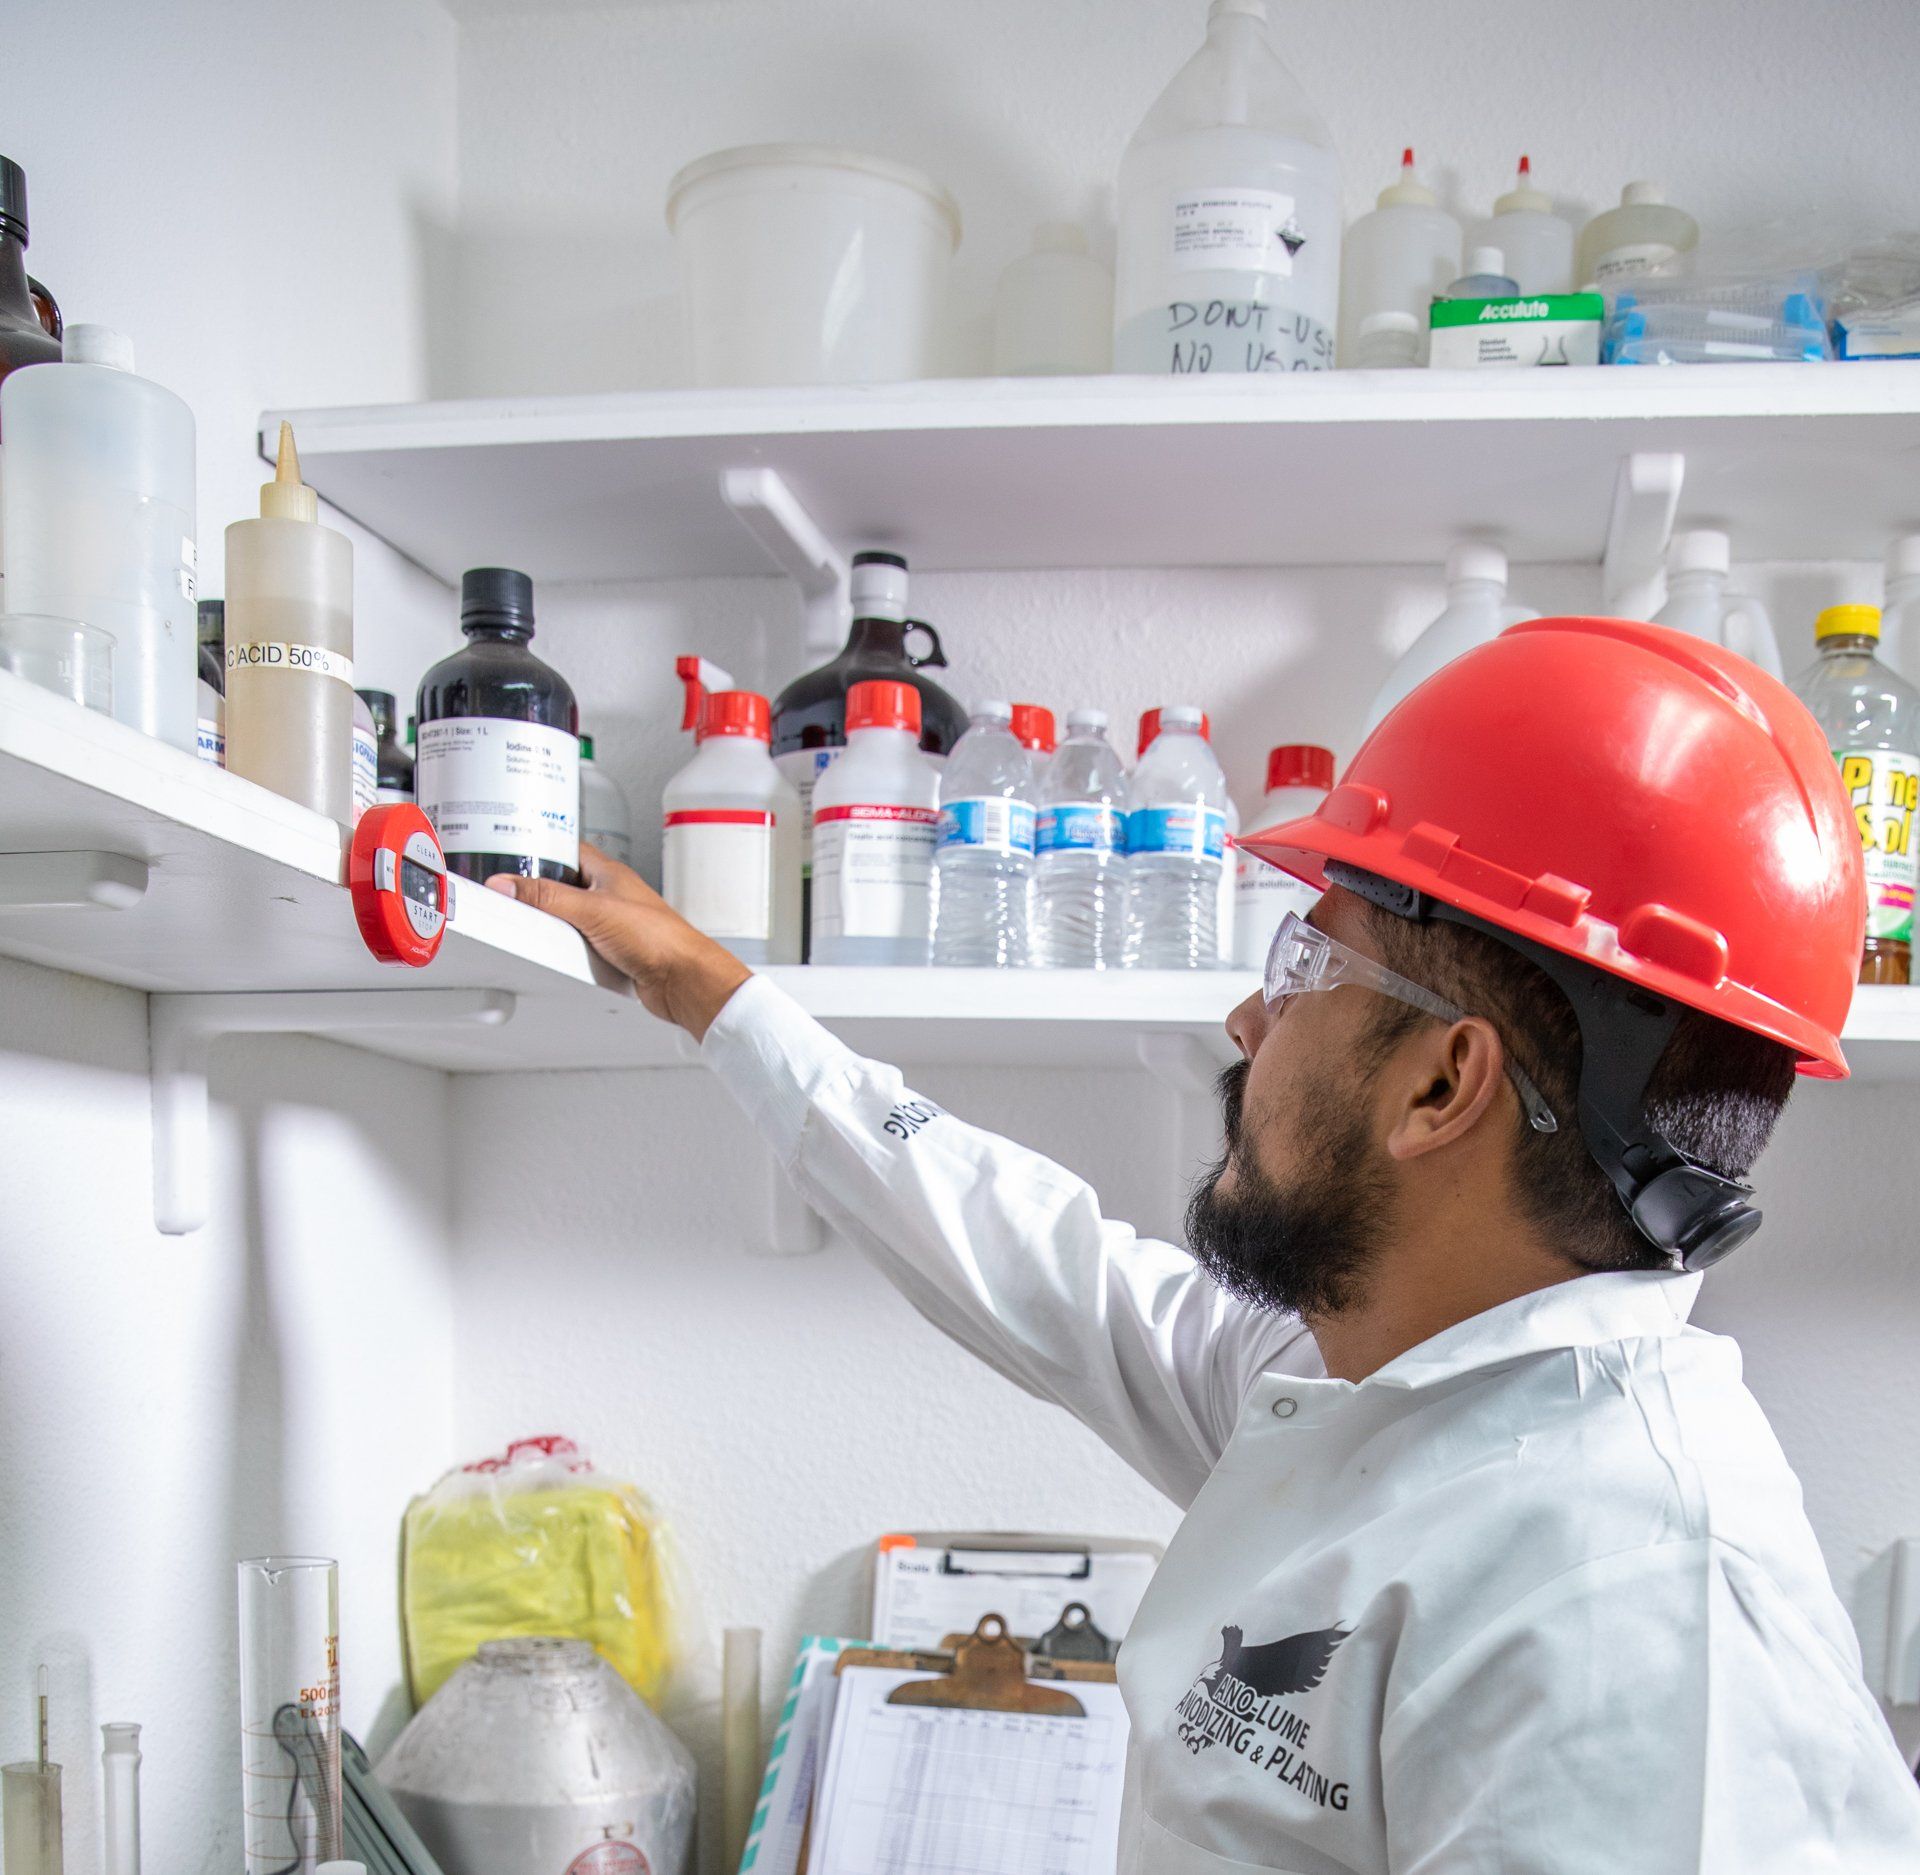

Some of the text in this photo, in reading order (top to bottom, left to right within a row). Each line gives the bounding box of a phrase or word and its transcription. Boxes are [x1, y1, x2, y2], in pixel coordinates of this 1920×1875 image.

[1478, 301, 1550, 320] Acculute
[1171, 341, 1213, 374] NO
[237, 645, 282, 665] ACID
[289, 647, 330, 671] 50%
[506, 741, 532, 753] Iodine
[416, 844, 436, 860] CLEAR
[414, 905, 438, 922] START
[1212, 1673, 1311, 1750] ANO-LUME
[1175, 1688, 1349, 1811] ANODIZING & PLATING
